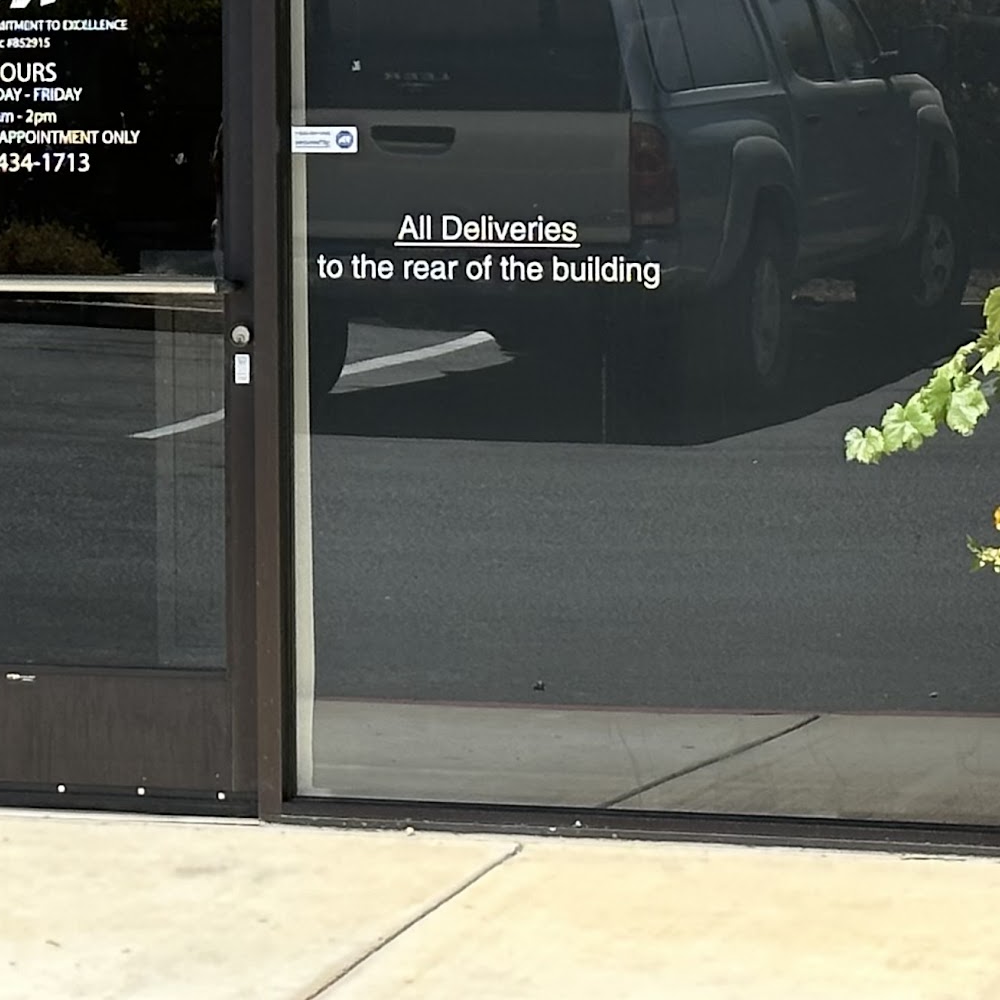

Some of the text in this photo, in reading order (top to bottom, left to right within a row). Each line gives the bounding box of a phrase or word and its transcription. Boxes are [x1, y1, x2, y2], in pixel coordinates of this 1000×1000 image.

[46, 20, 61, 31] TO
[62, 19, 128, 31] EXCELLENCE
[7, 37, 50, 48] #852915
[33, 87, 82, 102] FRIDAY
[25, 109, 57, 126] 2pm
[101, 130, 141, 145] ONLY
[398, 215, 578, 242] All Deliveries
[317, 254, 661, 290] to the rear of the building
